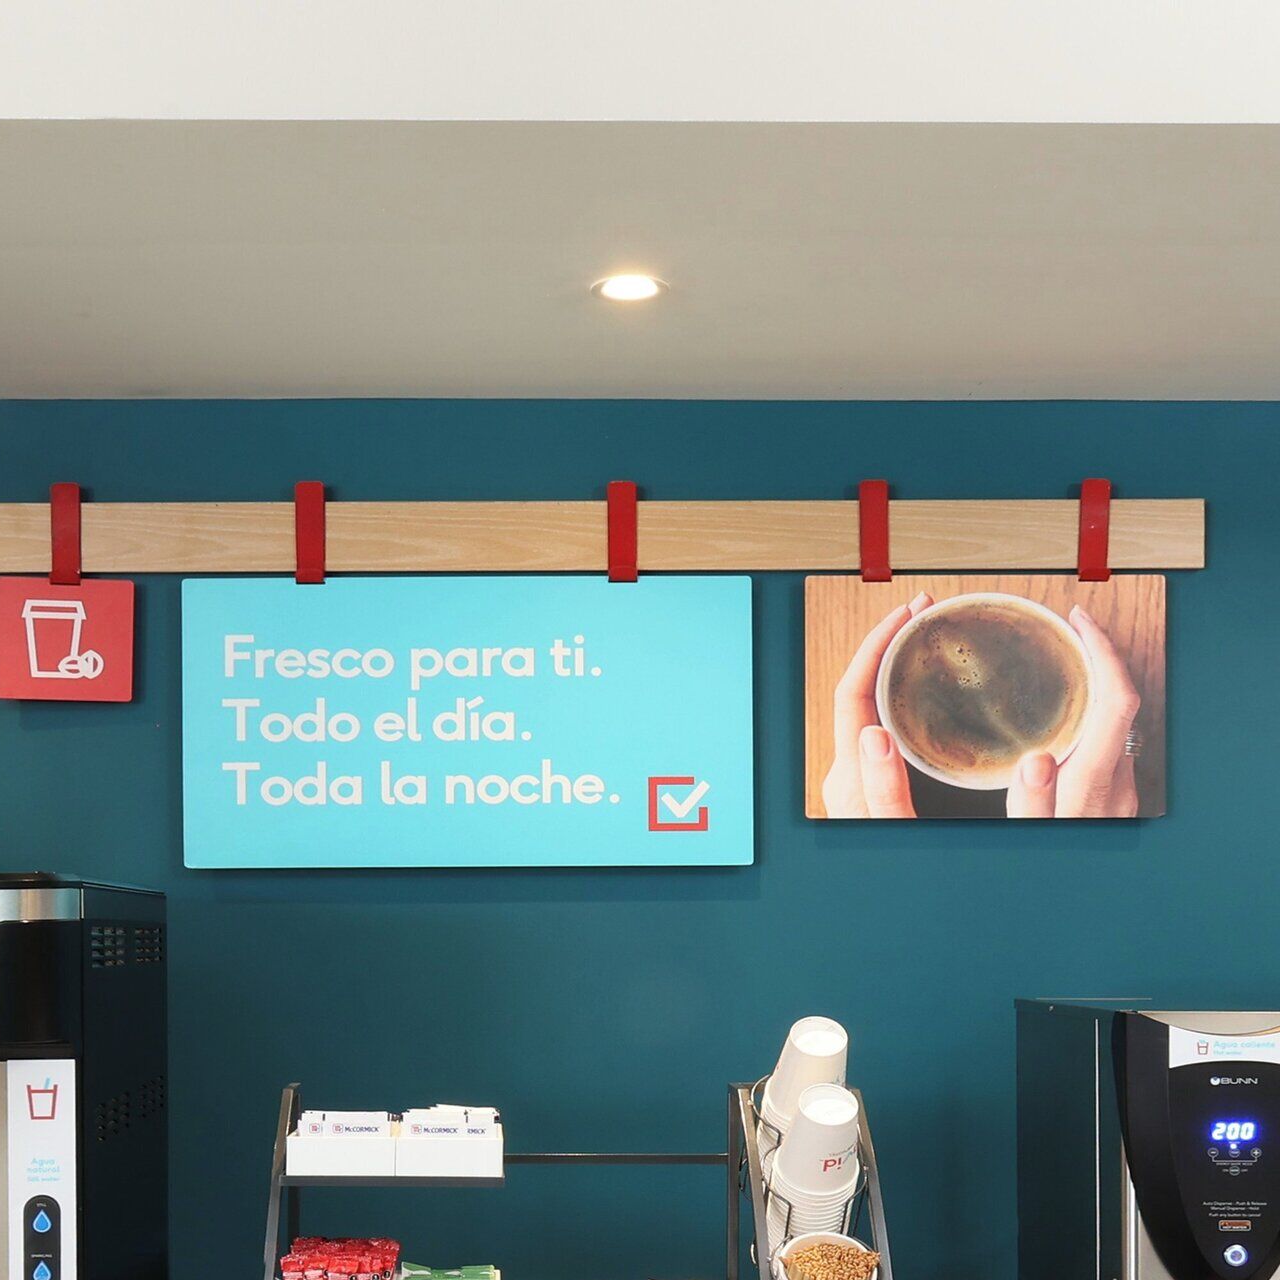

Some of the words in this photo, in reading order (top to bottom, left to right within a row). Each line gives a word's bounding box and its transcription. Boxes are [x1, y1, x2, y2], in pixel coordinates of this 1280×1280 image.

[223, 634, 395, 679] Fresco
[410, 646, 535, 691] para
[549, 634, 603, 678] ti.
[221, 697, 361, 743] Todo
[373, 697, 423, 743] el
[431, 695, 533, 743] día.
[221, 760, 363, 807] Toda
[380, 760, 427, 806] la
[444, 758, 621, 806] noche.
[1213, 1041, 1238, 1049] Agua
[1240, 1040, 1276, 1049] caliente
[1220, 1077, 1258, 1085] BUNN
[1211, 1122, 1255, 1140] 200
[31, 1158, 55, 1167] Agua
[27, 1165, 60, 1174] natural
